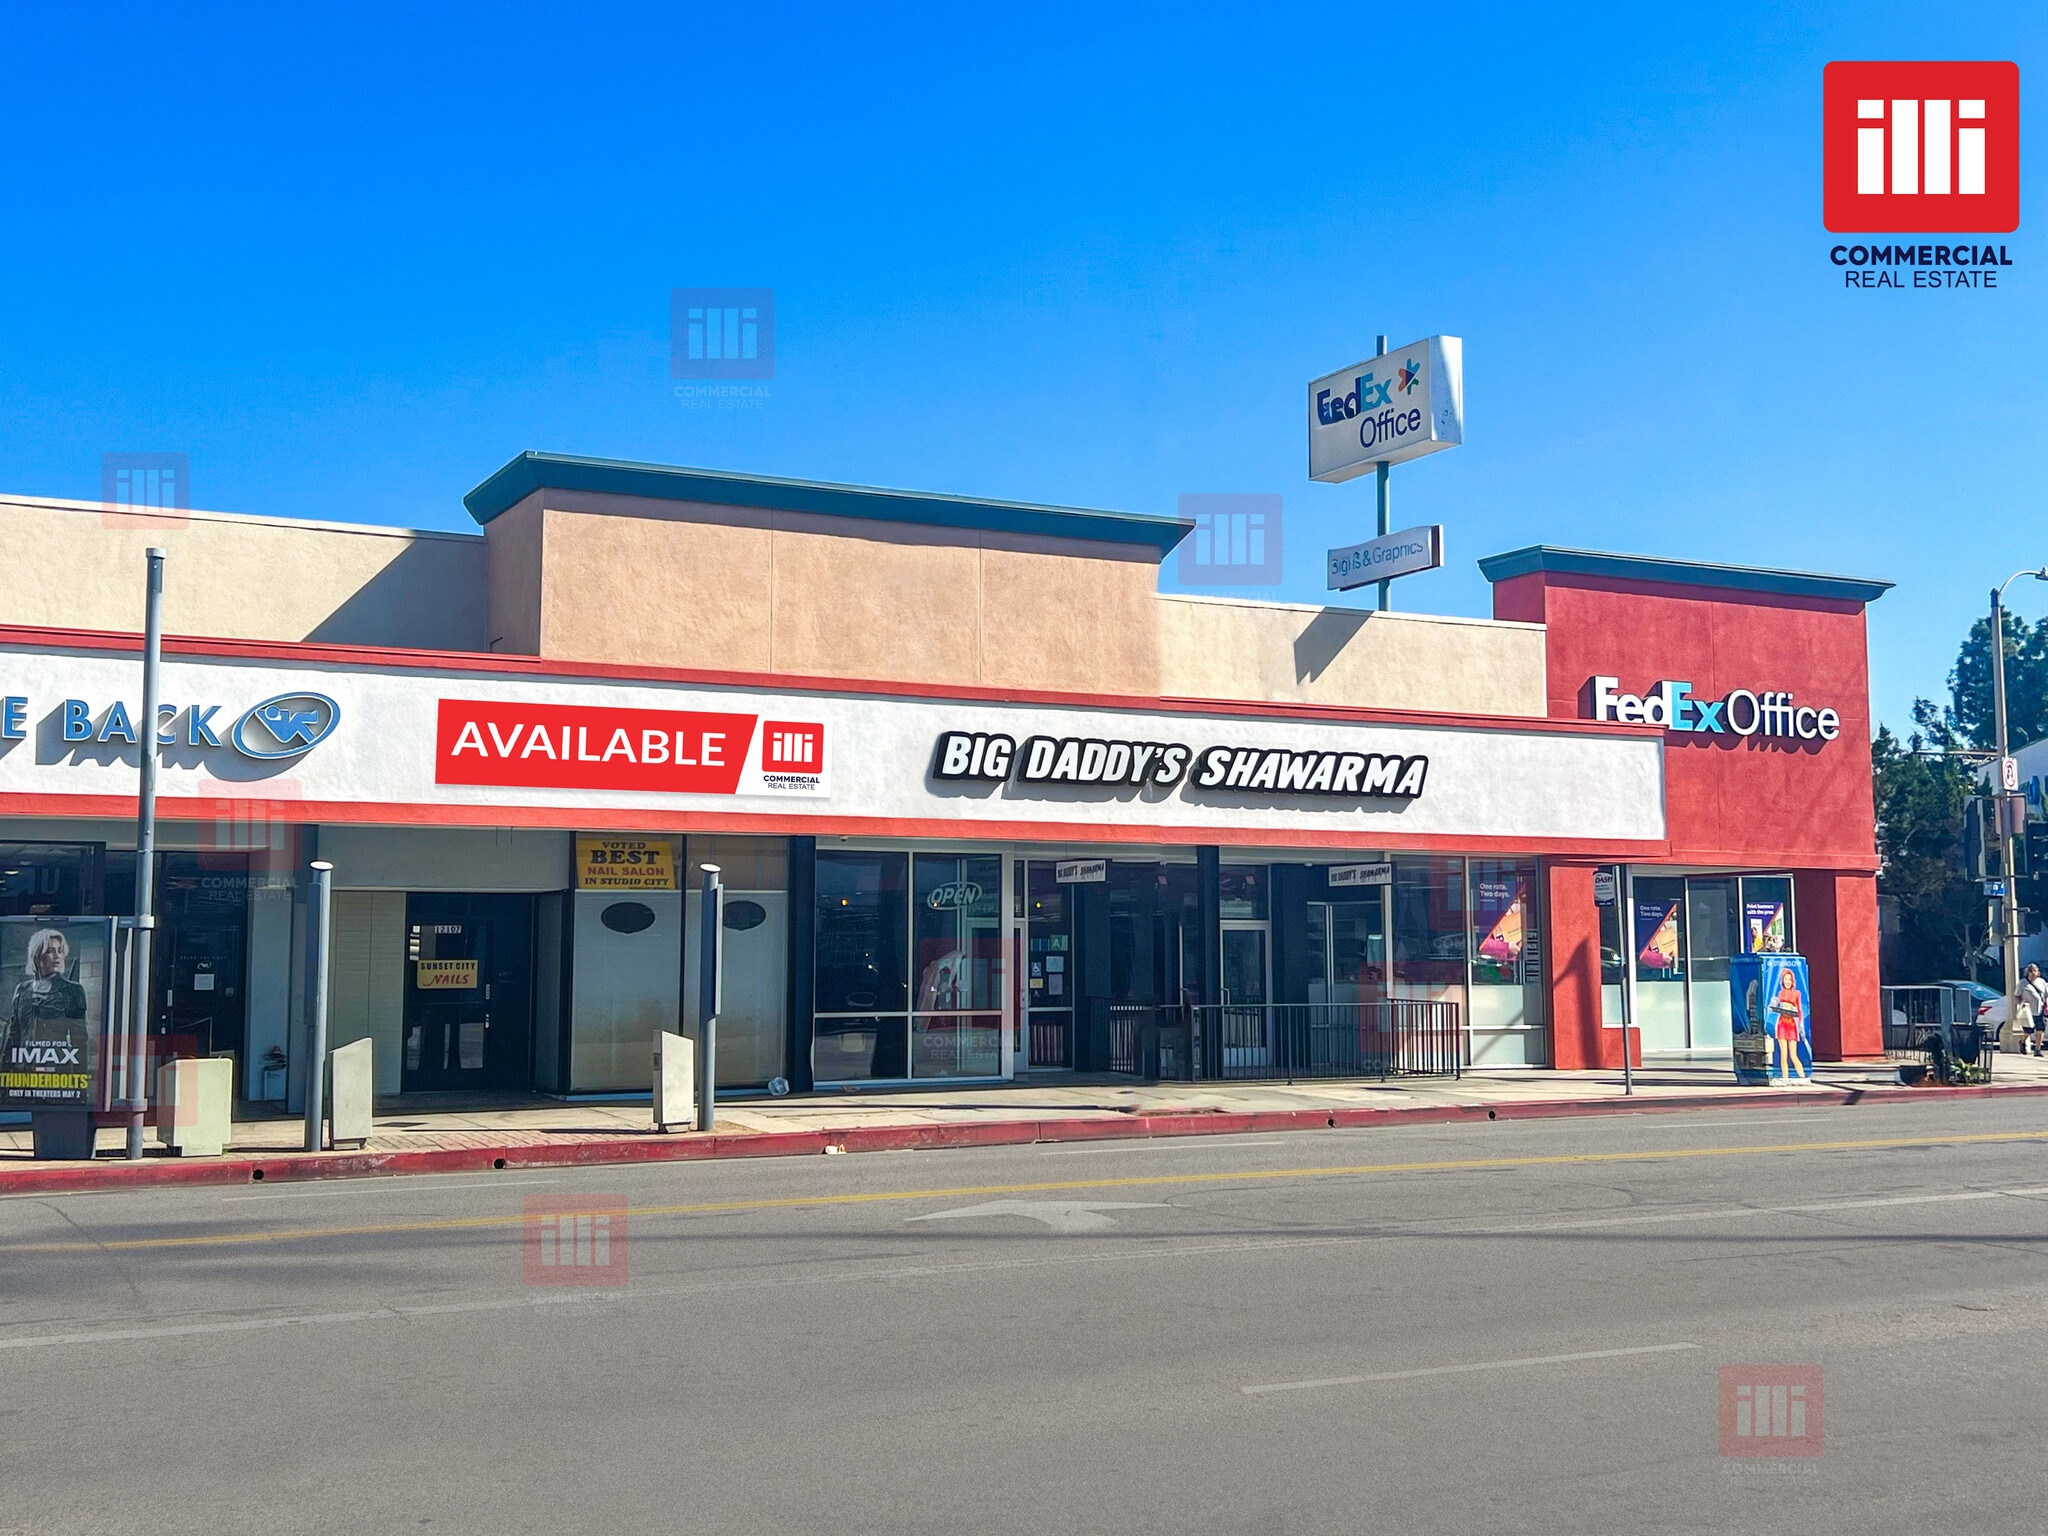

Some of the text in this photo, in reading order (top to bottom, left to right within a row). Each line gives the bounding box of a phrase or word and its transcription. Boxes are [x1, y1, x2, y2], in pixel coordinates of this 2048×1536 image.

[1316, 372, 1393, 426] FedEx
[1360, 407, 1421, 448] Office
[1595, 676, 1841, 741] FedEx Office
[63, 698, 223, 747] BACK
[451, 721, 727, 767] AVAILABLE
[772, 732, 814, 763] illi
[942, 735, 1427, 794] BIG DADDY'S SHAWARMA
[763, 774, 821, 784] COMMERCIAL
[788, 783, 816, 791] ESTATE
[602, 841, 646, 850] VOTED
[590, 850, 660, 864] BEST
[587, 866, 665, 876] NAIL SALON
[584, 877, 669, 886] IN STUDIO CITY
[930, 887, 977, 905] OPEN
[1494, 890, 1510, 899] days.
[420, 962, 476, 970] SUNSET CITY
[423, 974, 470, 986] NAILS
[11, 1047, 79, 1064] IMAX
[32, 1090, 61, 1098] THEATERS
[62, 1090, 75, 1098] MAY
[75, 1091, 81, 1099] 2
